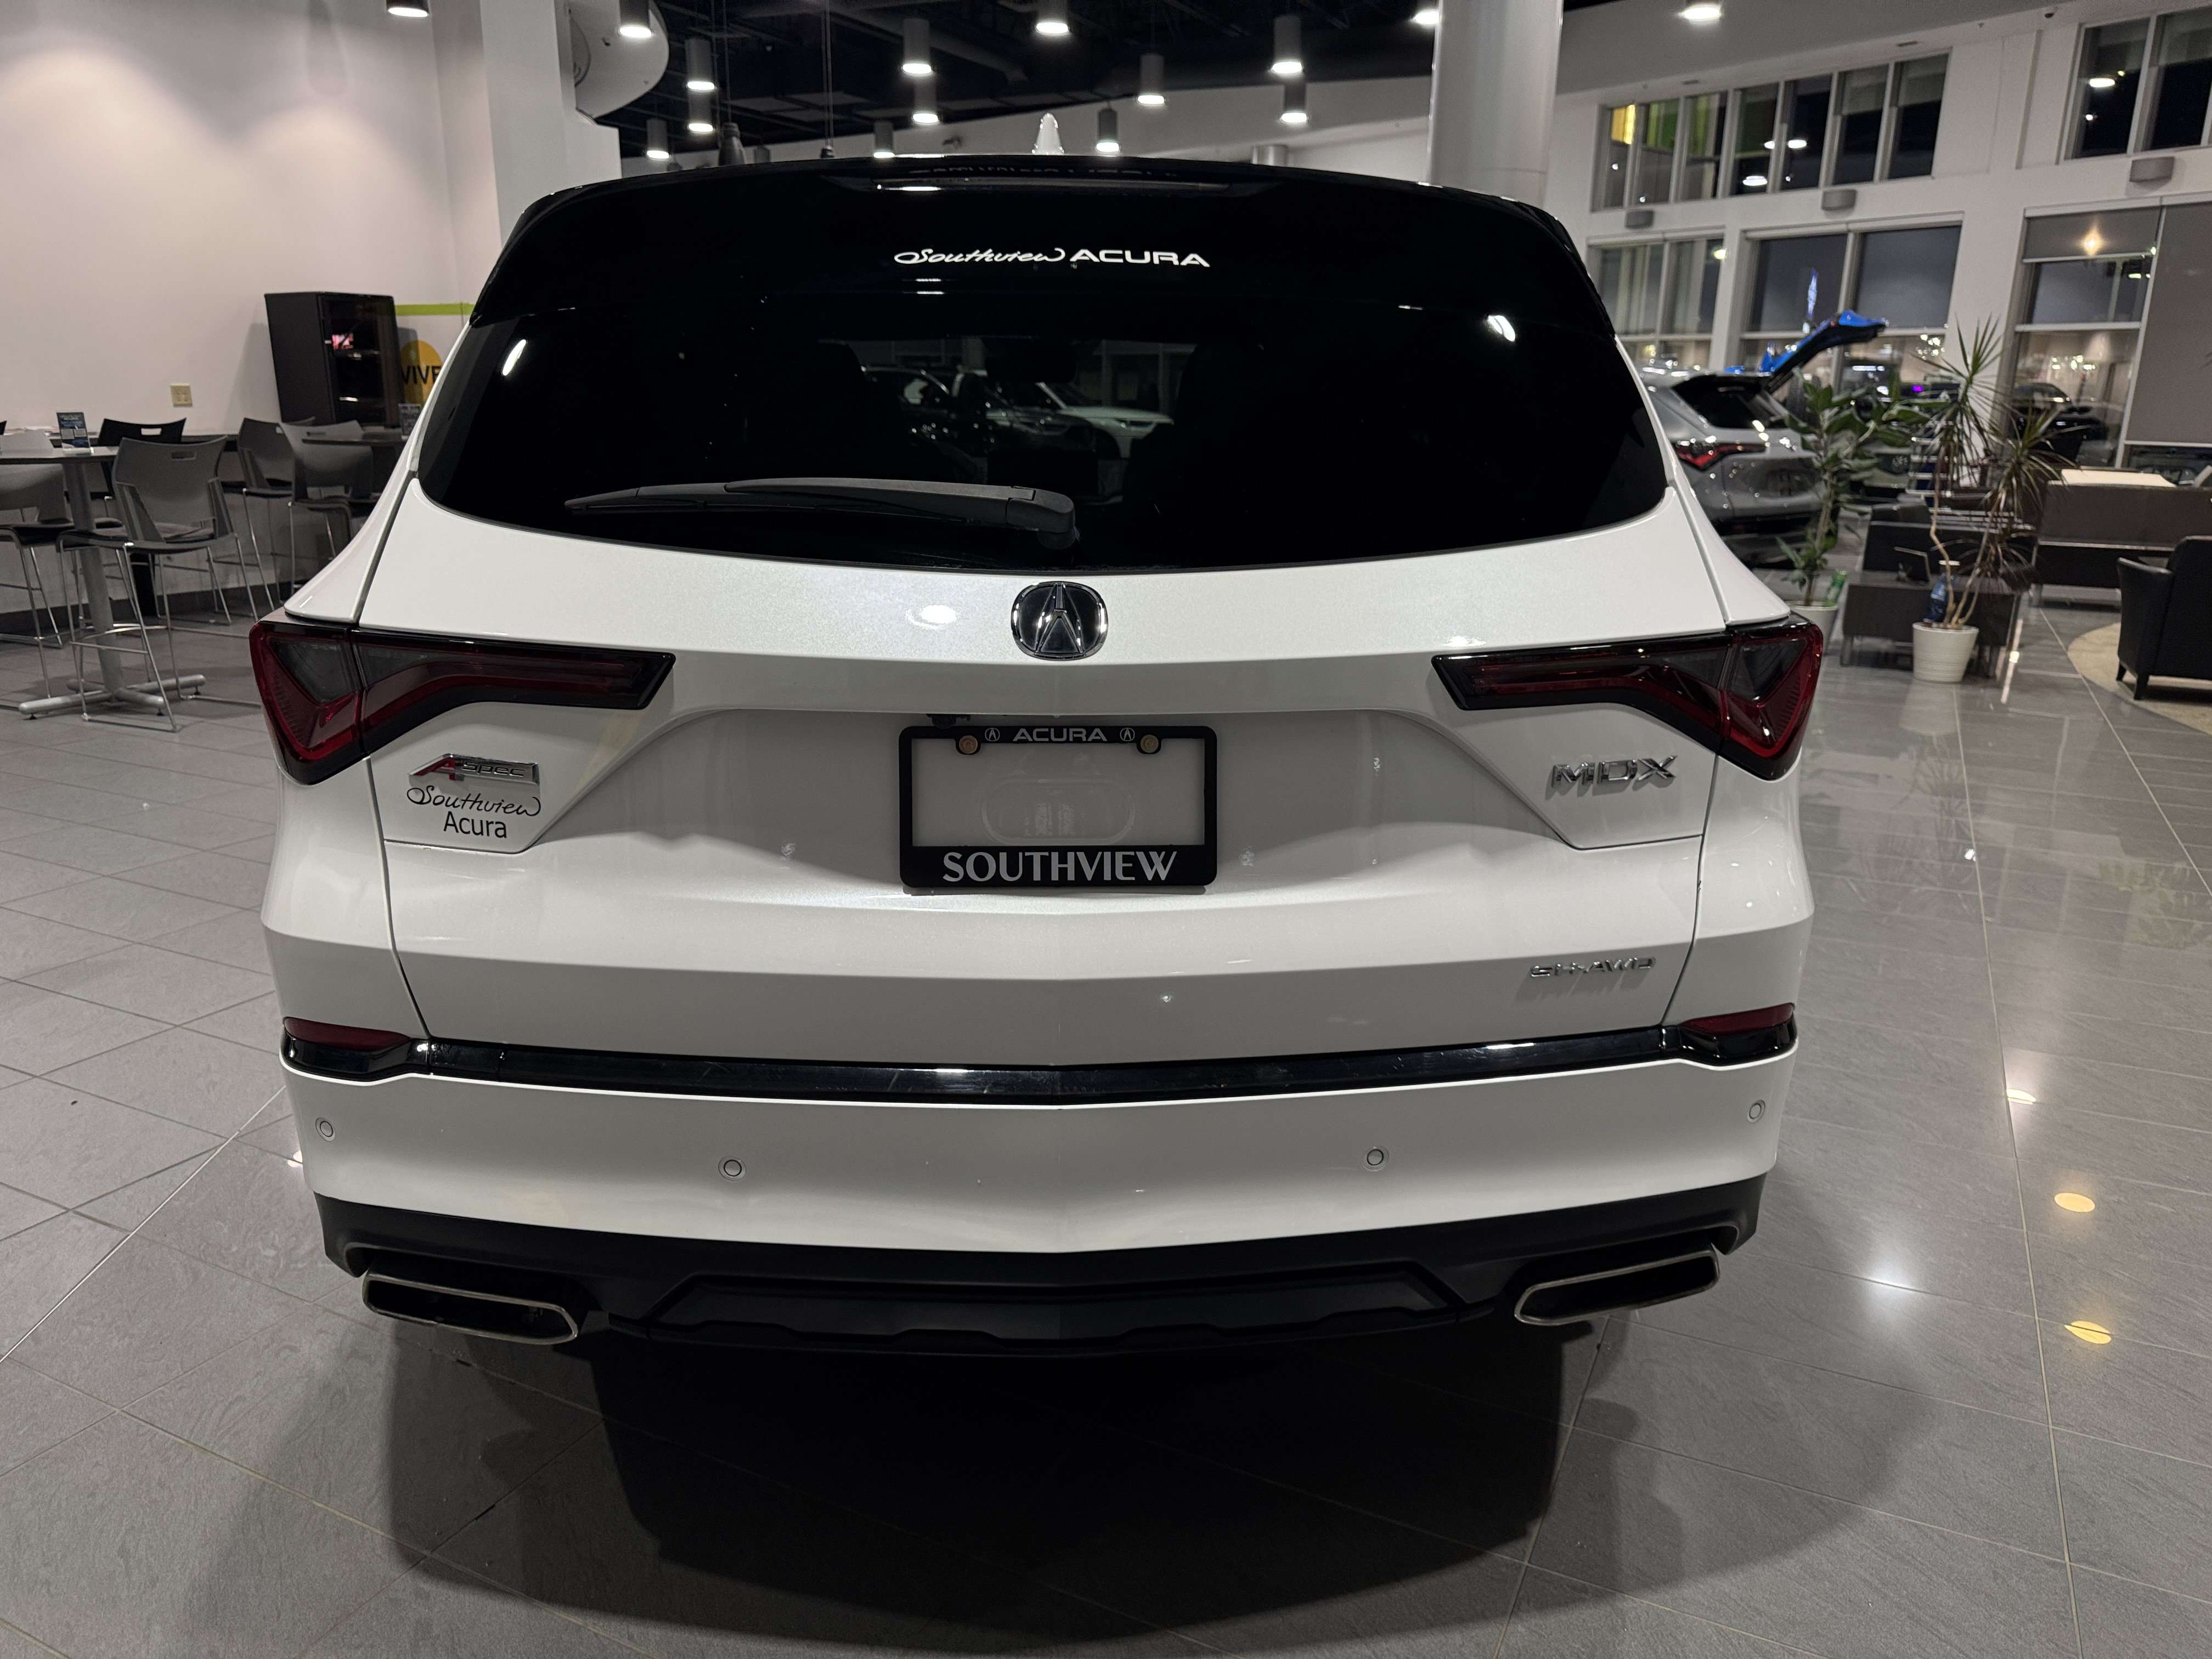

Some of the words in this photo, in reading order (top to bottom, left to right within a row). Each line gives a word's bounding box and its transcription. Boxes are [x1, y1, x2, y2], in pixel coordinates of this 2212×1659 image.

[894, 247, 1066, 264] Southview
[1069, 249, 1210, 267] ACURA
[1013, 728, 1107, 742] ACURA
[1550, 755, 1678, 788] MDX
[407, 785, 541, 816] Southview
[443, 810, 507, 839] Acura
[943, 851, 1177, 882] SOUTHVIEW
